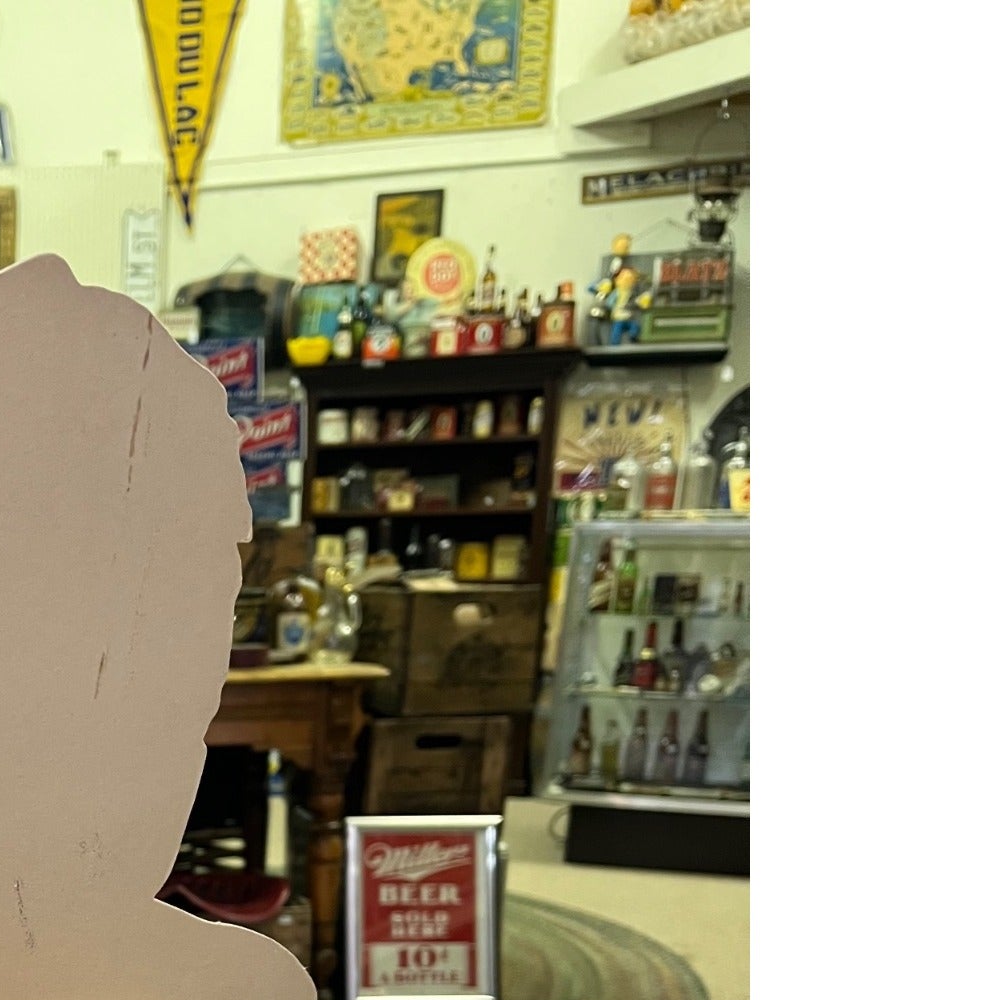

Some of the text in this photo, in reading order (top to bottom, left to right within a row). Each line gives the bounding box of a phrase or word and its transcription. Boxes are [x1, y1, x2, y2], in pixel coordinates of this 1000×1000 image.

[365, 841, 472, 880] Miller
[378, 883, 461, 906] BEER
[390, 910, 450, 923] SOLD
[390, 923, 450, 938] HERE
[394, 970, 461, 984] BOTTLE
